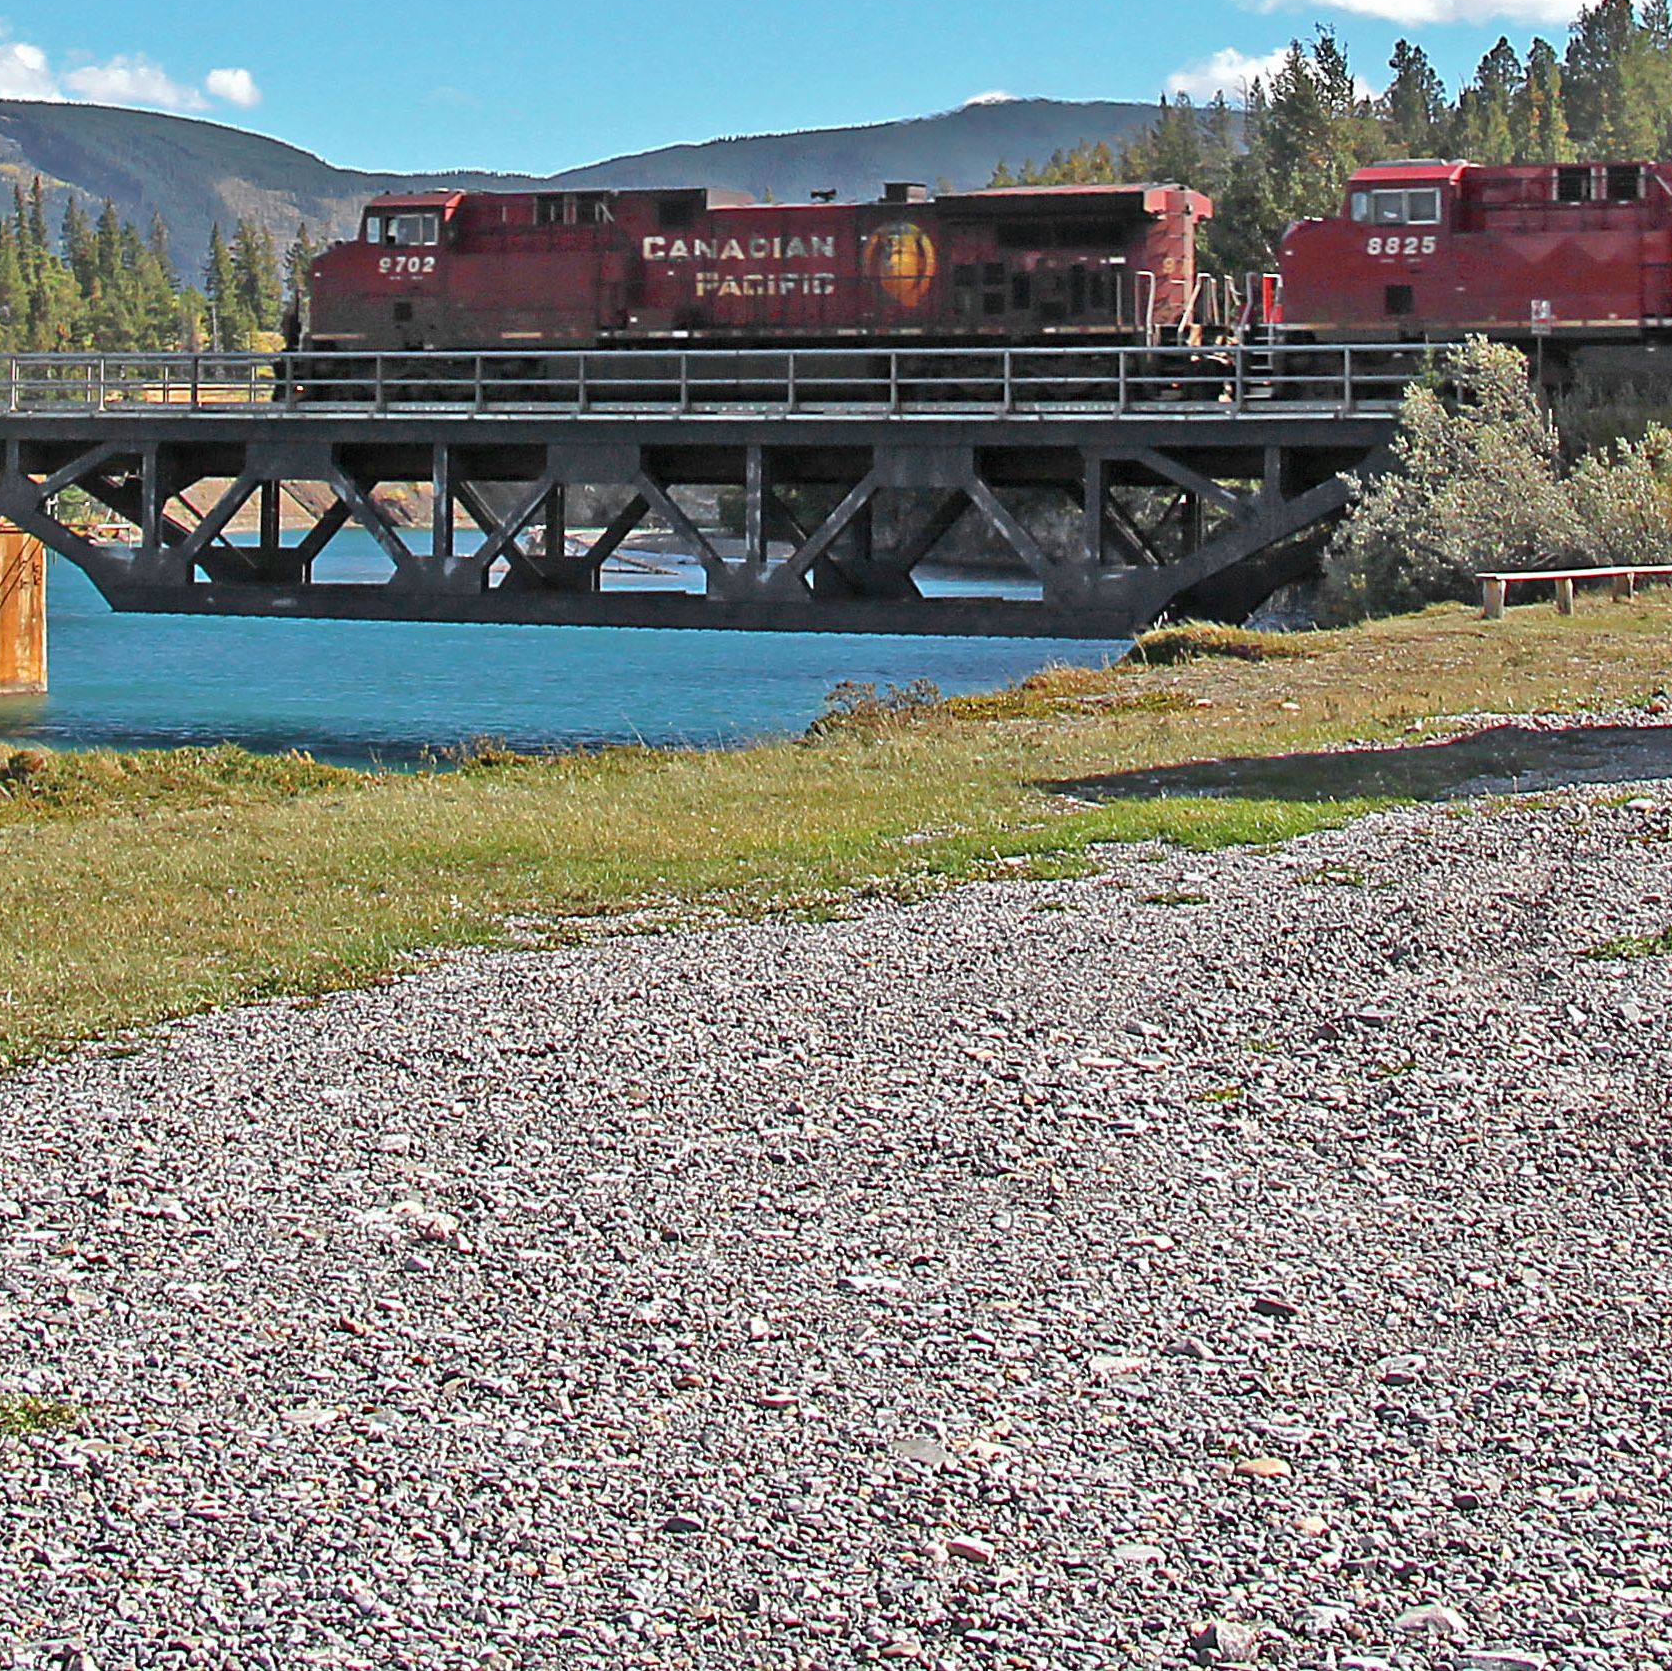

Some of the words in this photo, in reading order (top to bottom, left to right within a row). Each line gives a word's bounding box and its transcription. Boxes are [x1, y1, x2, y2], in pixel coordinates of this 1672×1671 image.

[642, 235, 835, 261] CANADIAN
[1367, 235, 1436, 255] 8825
[378, 256, 436, 274] 9702
[695, 271, 835, 297] PACIFIC
